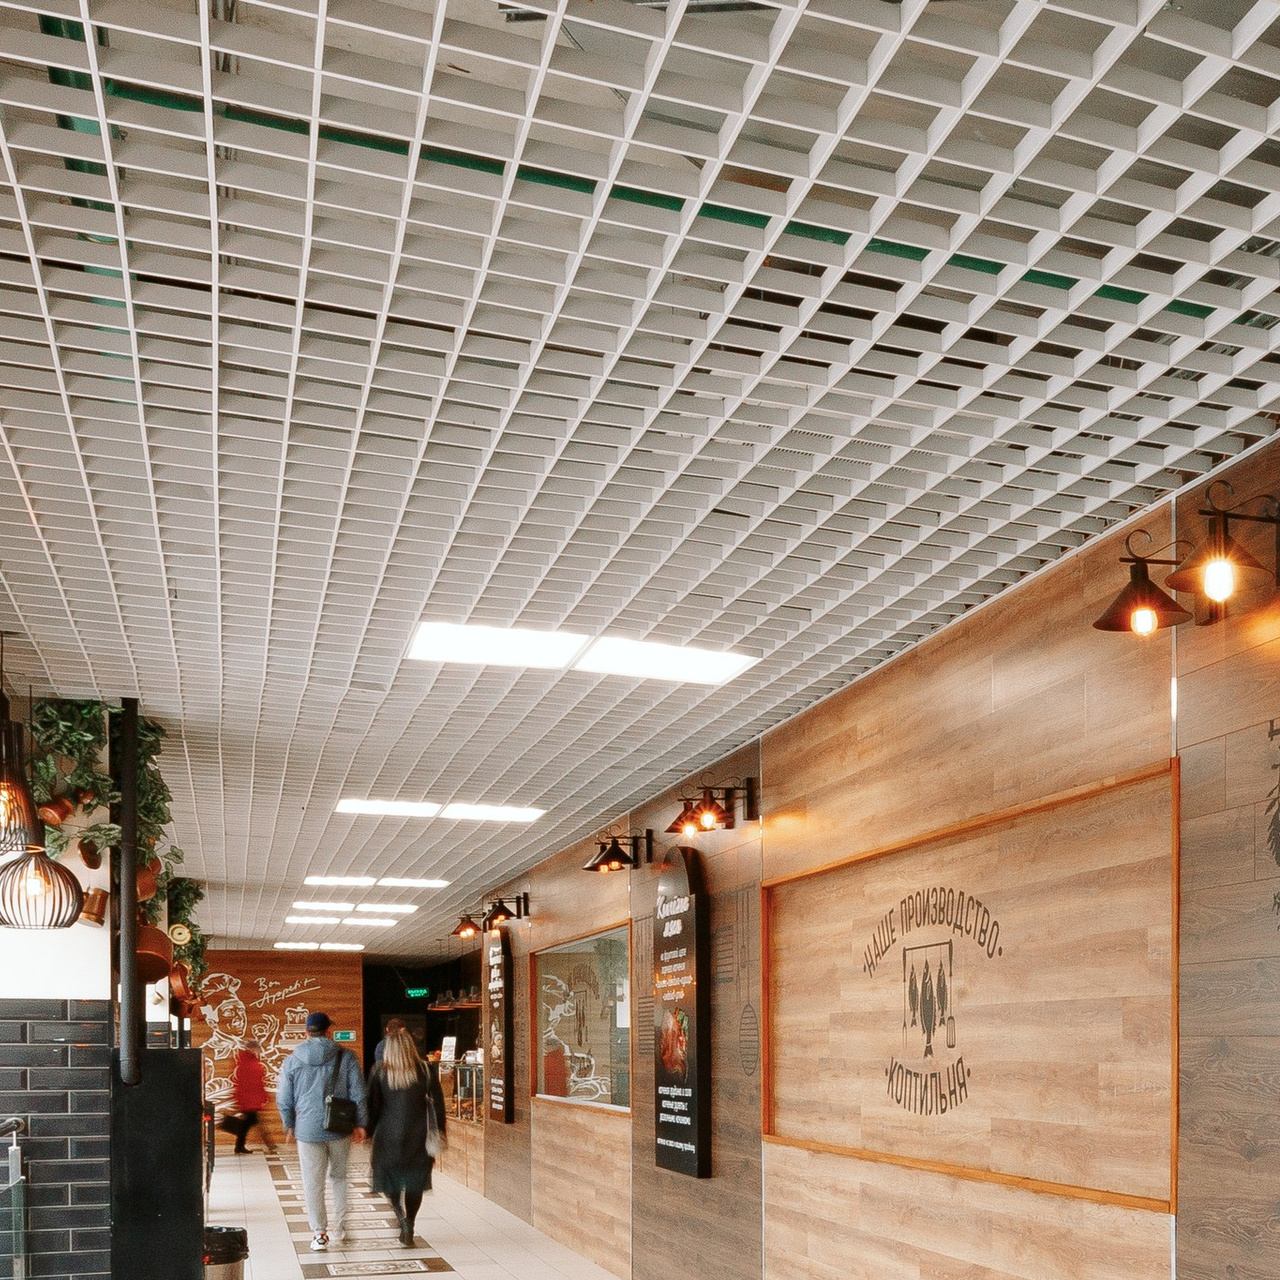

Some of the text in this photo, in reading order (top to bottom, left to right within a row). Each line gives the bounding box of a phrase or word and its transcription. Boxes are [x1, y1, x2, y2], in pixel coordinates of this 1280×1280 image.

[865, 886, 1000, 979] НАШЕ ПРОИЗВОДСТВО
[253, 977, 281, 992] Bon
[886, 1056, 969, 1117] КОПТИЛЬНЯ
